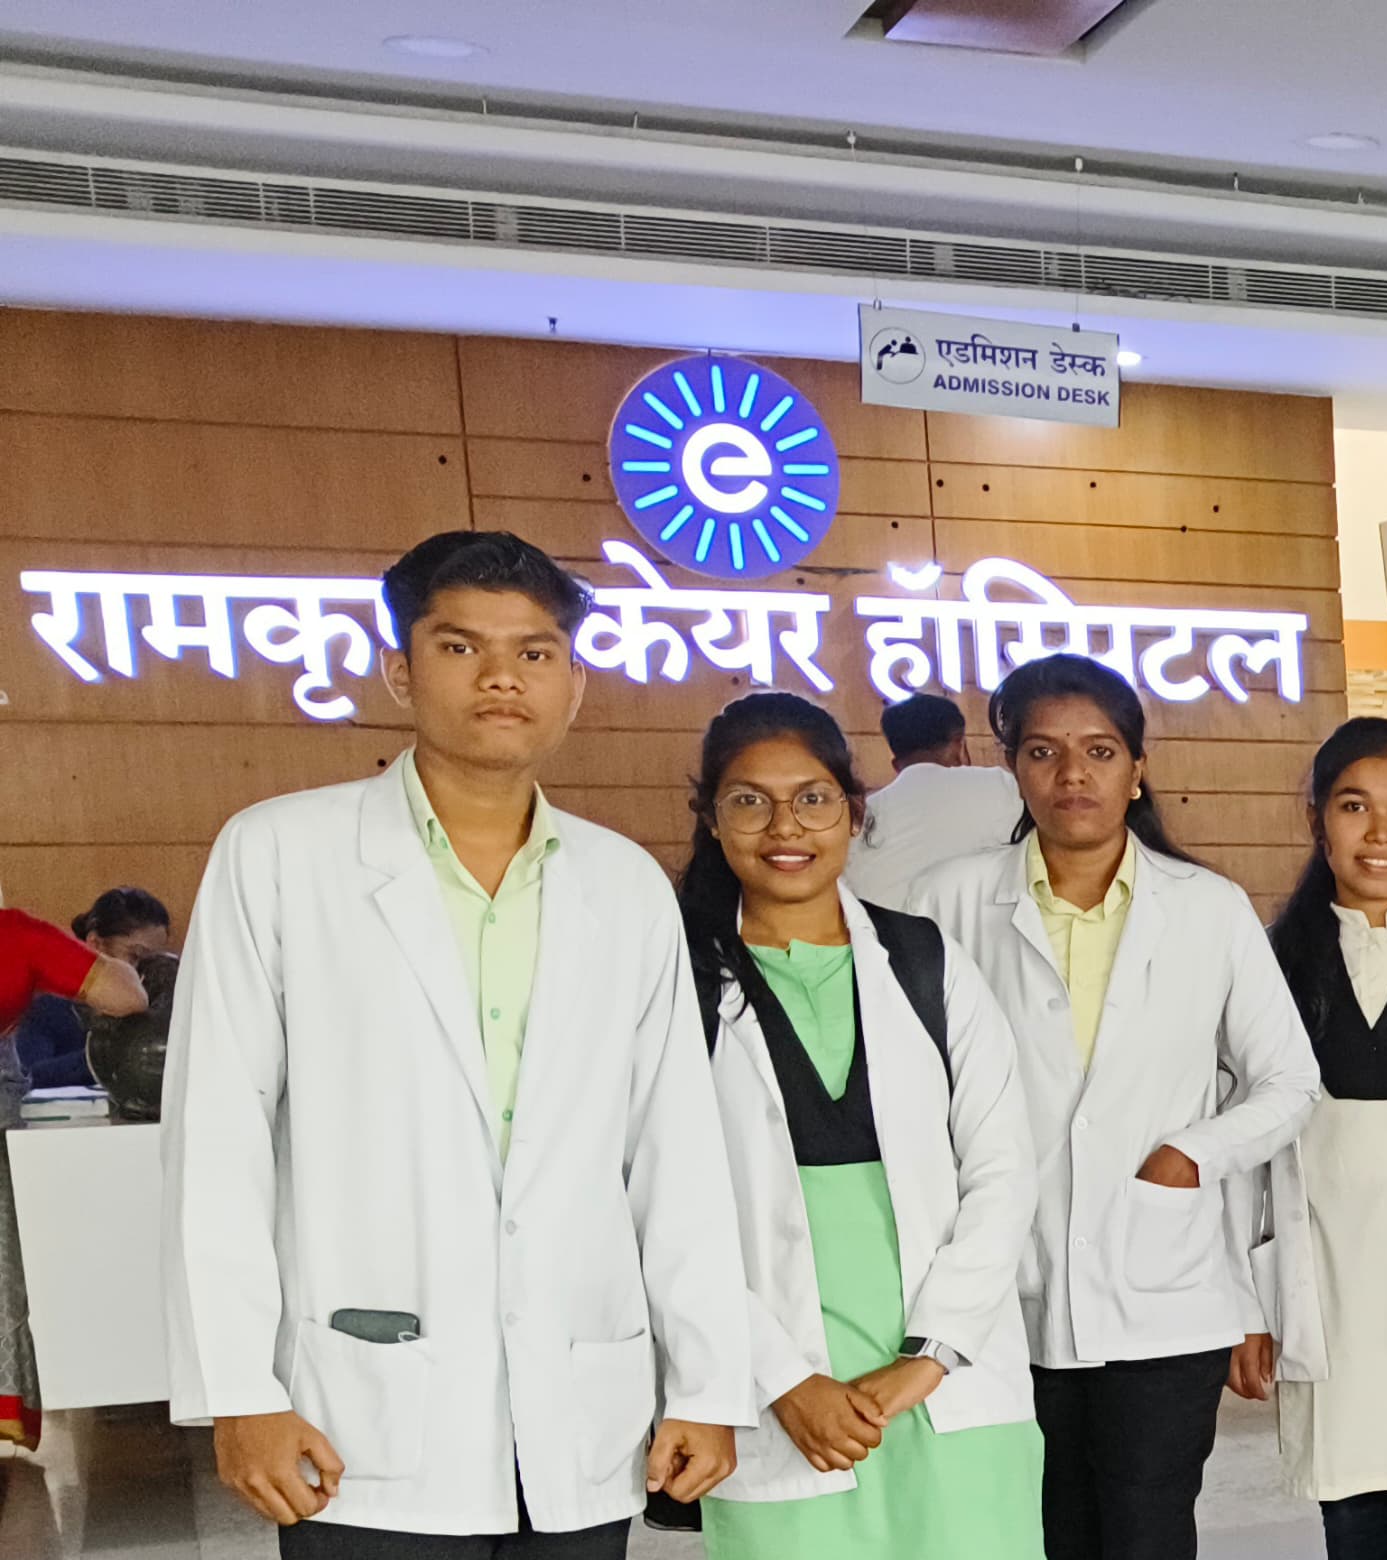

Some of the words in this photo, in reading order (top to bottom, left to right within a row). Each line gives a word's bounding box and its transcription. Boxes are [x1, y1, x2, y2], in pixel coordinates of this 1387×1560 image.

[935, 333, 1039, 371] एडमिशन
[1050, 342, 1106, 378] डेस्क
[933, 374, 1051, 401] ADMISSION
[1057, 387, 1111, 407] DESK
[19, 569, 399, 721] रामकृ
[573, 538, 836, 693] केयर
[855, 556, 1309, 704] हॉस्पिटल
